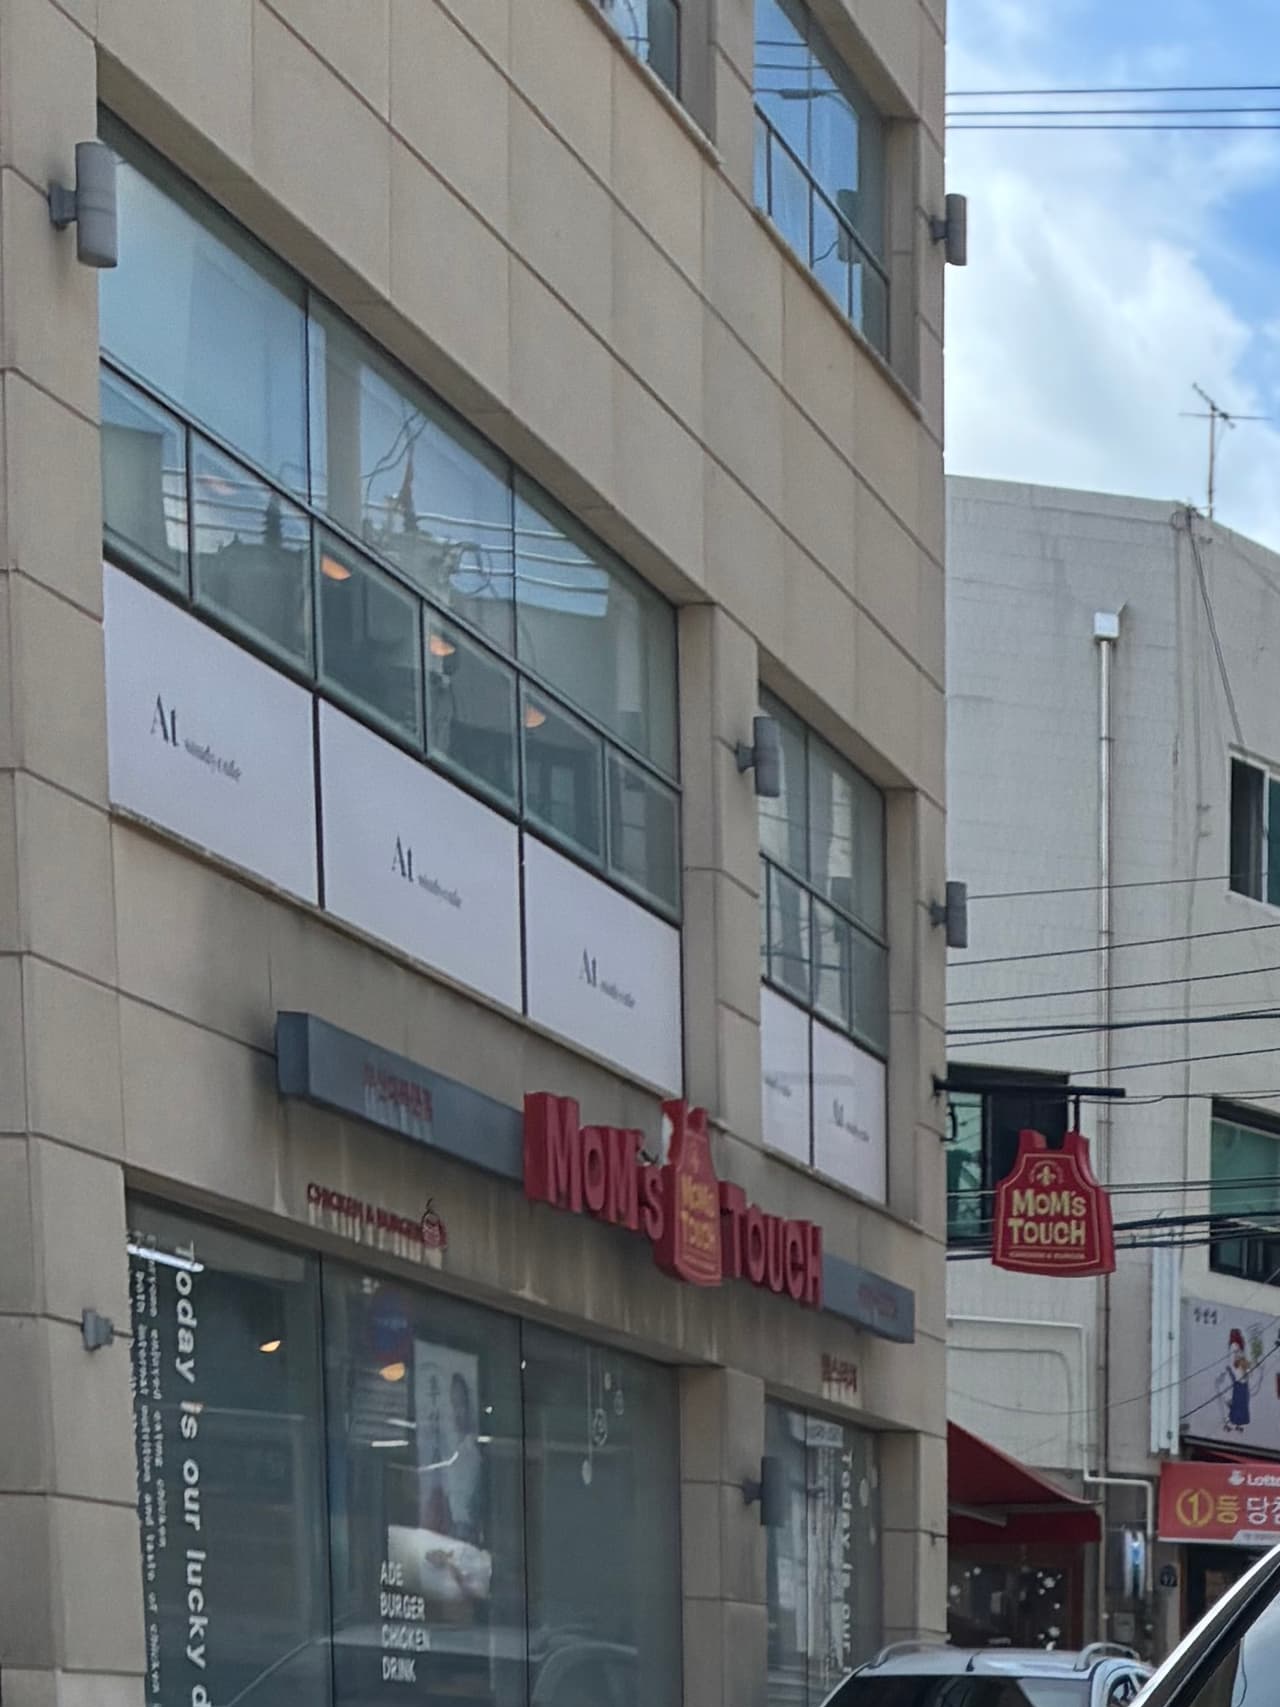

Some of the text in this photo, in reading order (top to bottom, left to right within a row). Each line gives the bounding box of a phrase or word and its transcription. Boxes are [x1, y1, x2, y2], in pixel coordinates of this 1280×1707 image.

[719, 1181, 824, 1312] TOUCH
[1007, 1217, 1086, 1245] TOUCH
[176, 1240, 198, 1384] Today
[180, 1401, 203, 1440] is
[183, 1459, 201, 1531] our
[380, 1560, 404, 1586] ADE
[186, 1550, 209, 1670] lucky
[380, 1594, 425, 1621] BURGER
[381, 1626, 431, 1651] CHICKEN
[382, 1656, 416, 1682] DRINK
